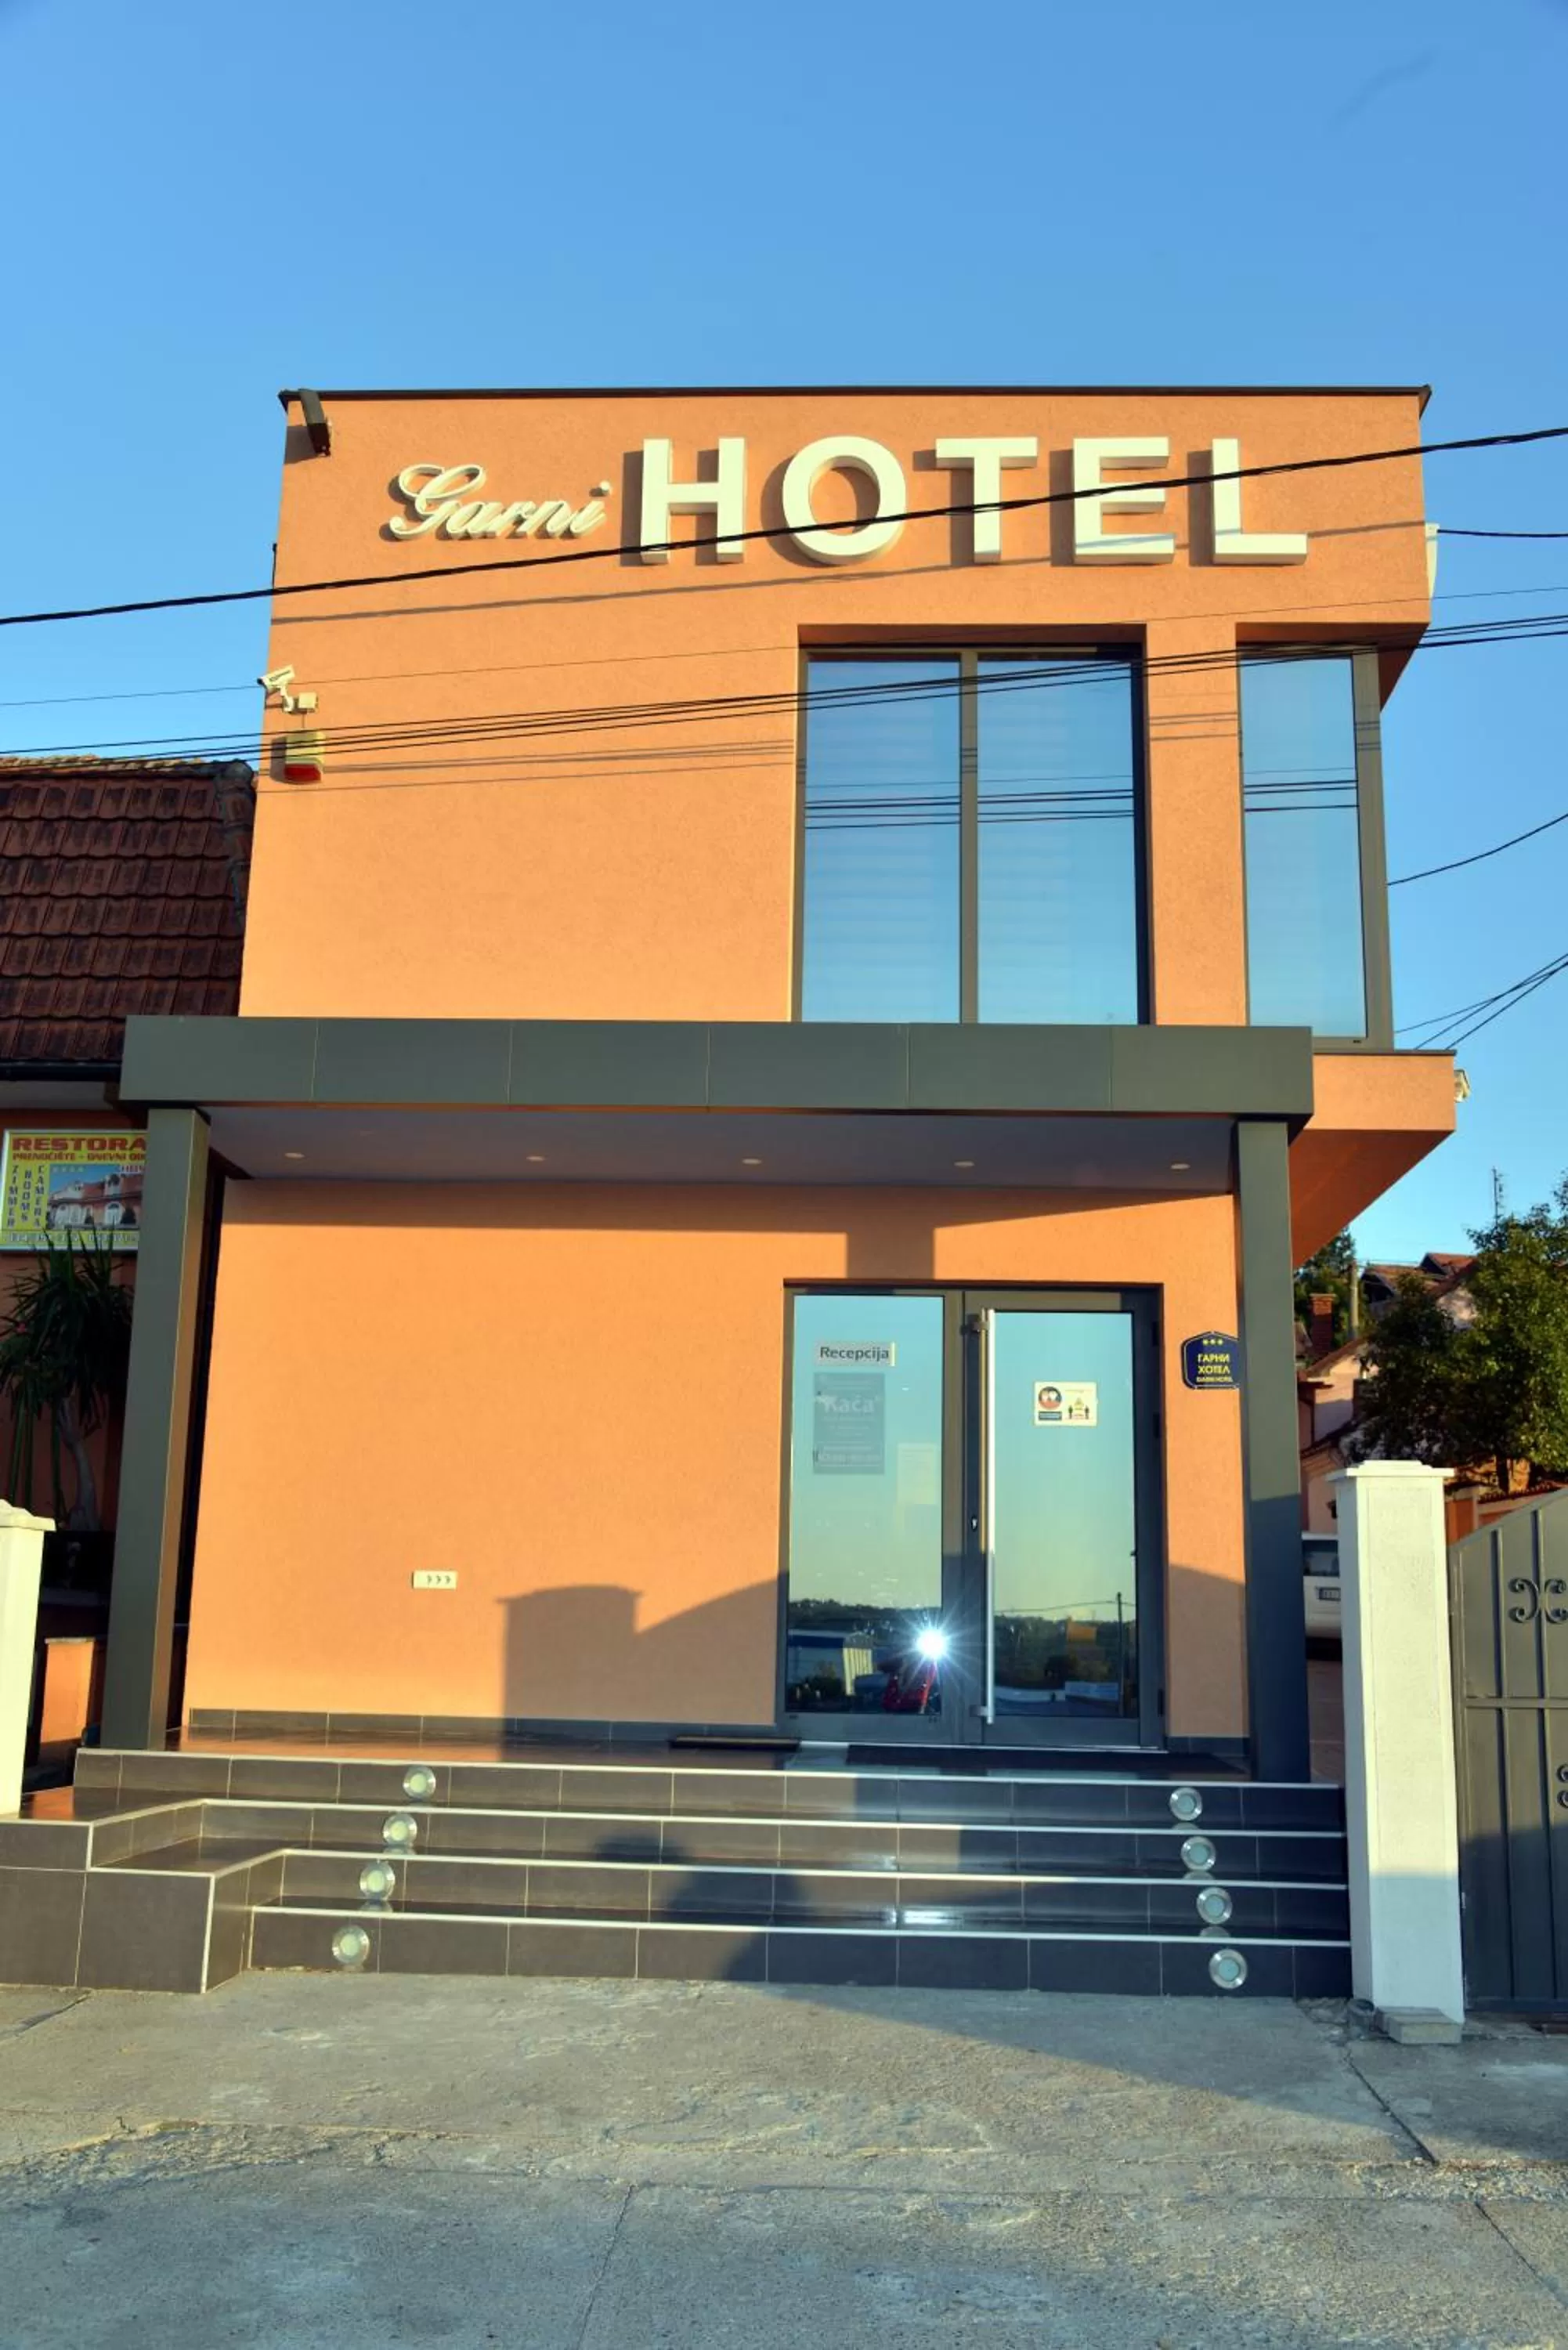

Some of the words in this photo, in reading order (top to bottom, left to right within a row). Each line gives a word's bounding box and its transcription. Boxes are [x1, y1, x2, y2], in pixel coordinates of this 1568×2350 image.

[389, 463, 612, 539] Garni
[639, 436, 1308, 566] HOTEL
[819, 1347, 890, 1361] Recepcija
[1198, 1354, 1230, 1362] ГАРНИ
